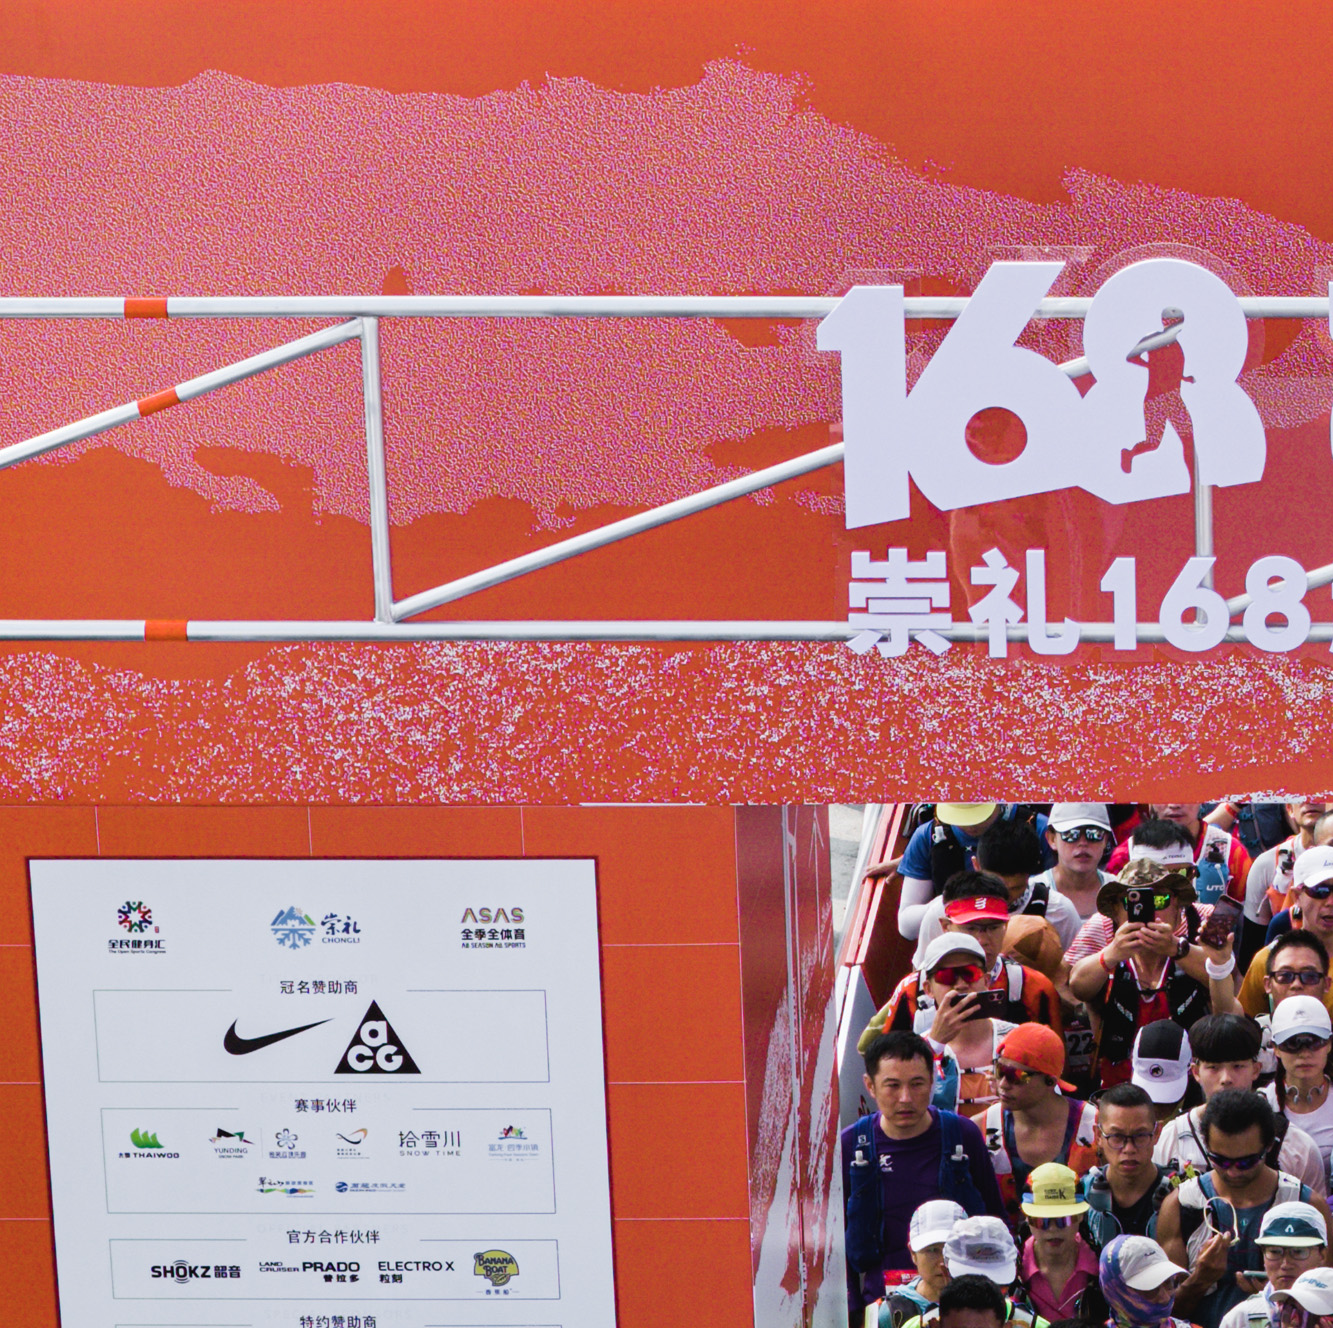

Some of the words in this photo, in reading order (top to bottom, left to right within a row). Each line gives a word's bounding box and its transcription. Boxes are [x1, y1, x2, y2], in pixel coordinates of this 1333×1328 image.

[816, 259, 1265, 530] 168
[461, 929, 525, 940] 全季全体育
[109, 940, 165, 950] 全民健身汇
[280, 980, 357, 994] 冠名赞助商
[295, 1099, 356, 1113] 赛事伙伴
[399, 1131, 460, 1148] 拾雪川
[287, 1230, 380, 1244] 官方合作伙伴
[151, 1266, 211, 1280] SHOKZ
[302, 1262, 360, 1272] PRADO
[378, 1261, 442, 1271] ELECTRO
[446, 1261, 454, 1271] X
[300, 1316, 376, 1328] 特约赞助商
